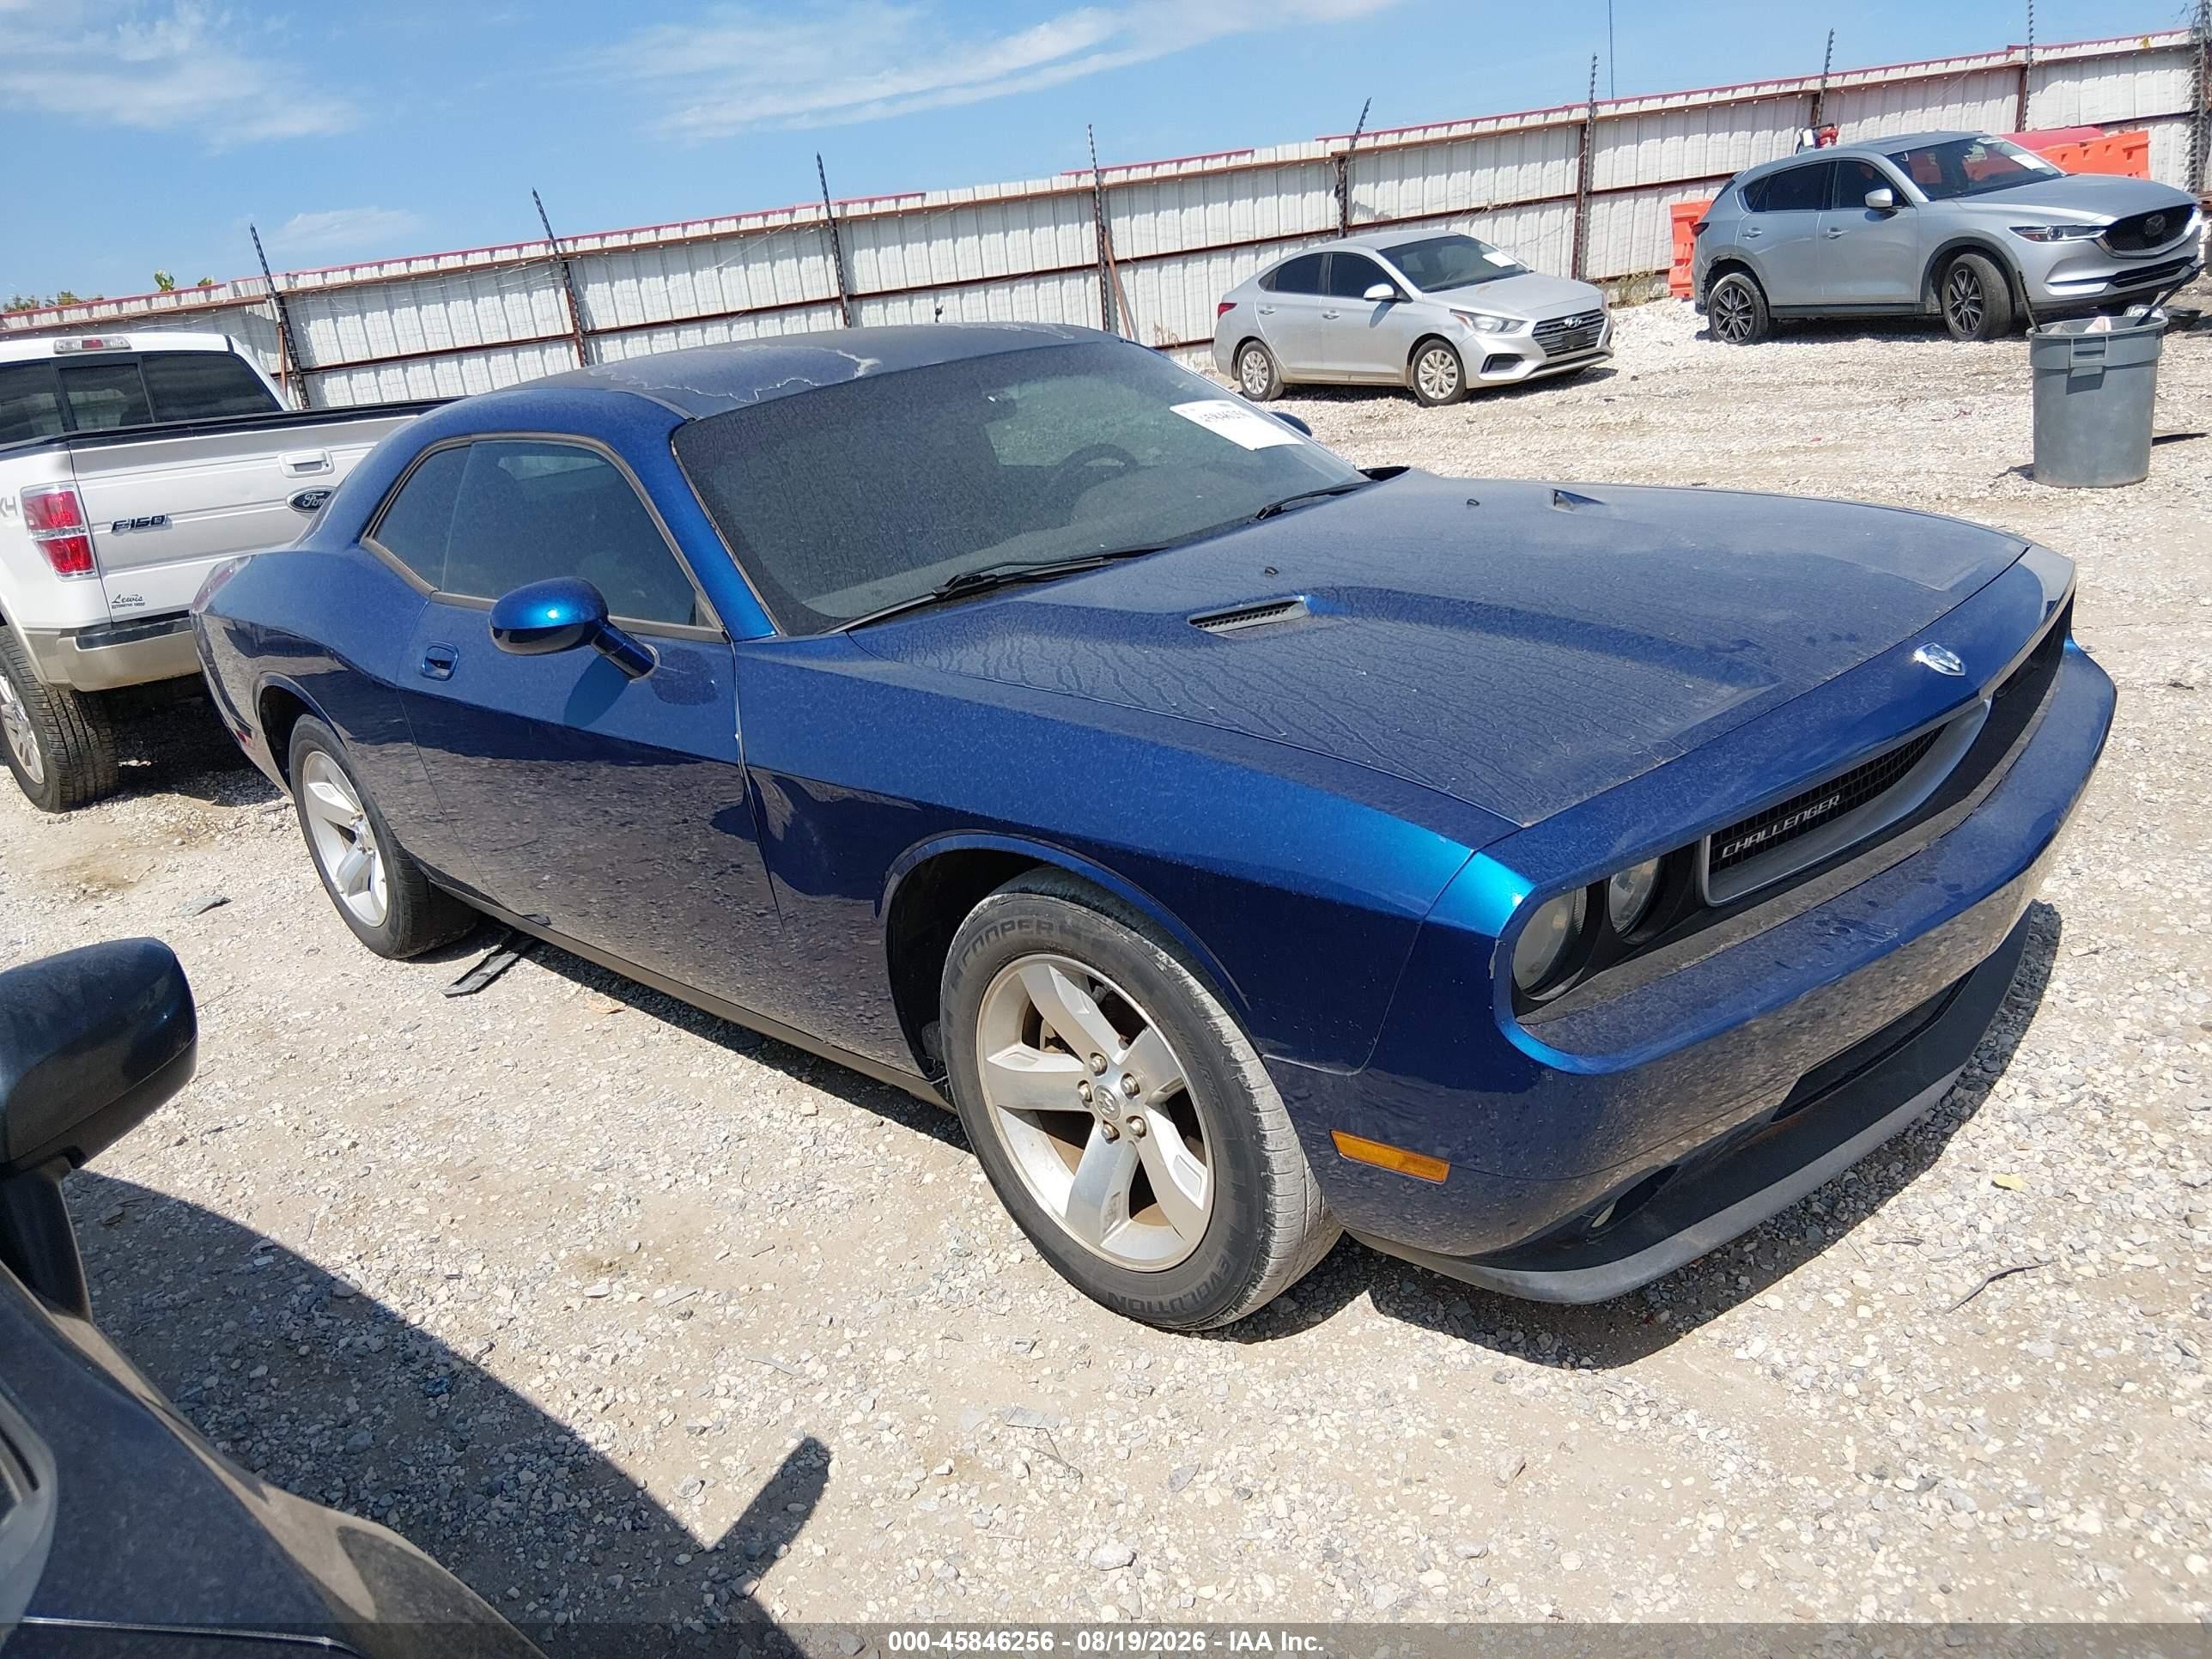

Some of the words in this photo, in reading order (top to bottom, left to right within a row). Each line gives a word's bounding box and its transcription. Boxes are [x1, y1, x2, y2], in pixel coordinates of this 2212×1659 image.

[302, 492, 325, 507] For
[1722, 794, 1840, 859] CHALLENGER
[961, 919, 1054, 969] COOPER
[1107, 1253, 1231, 1315] EVOLUTION
